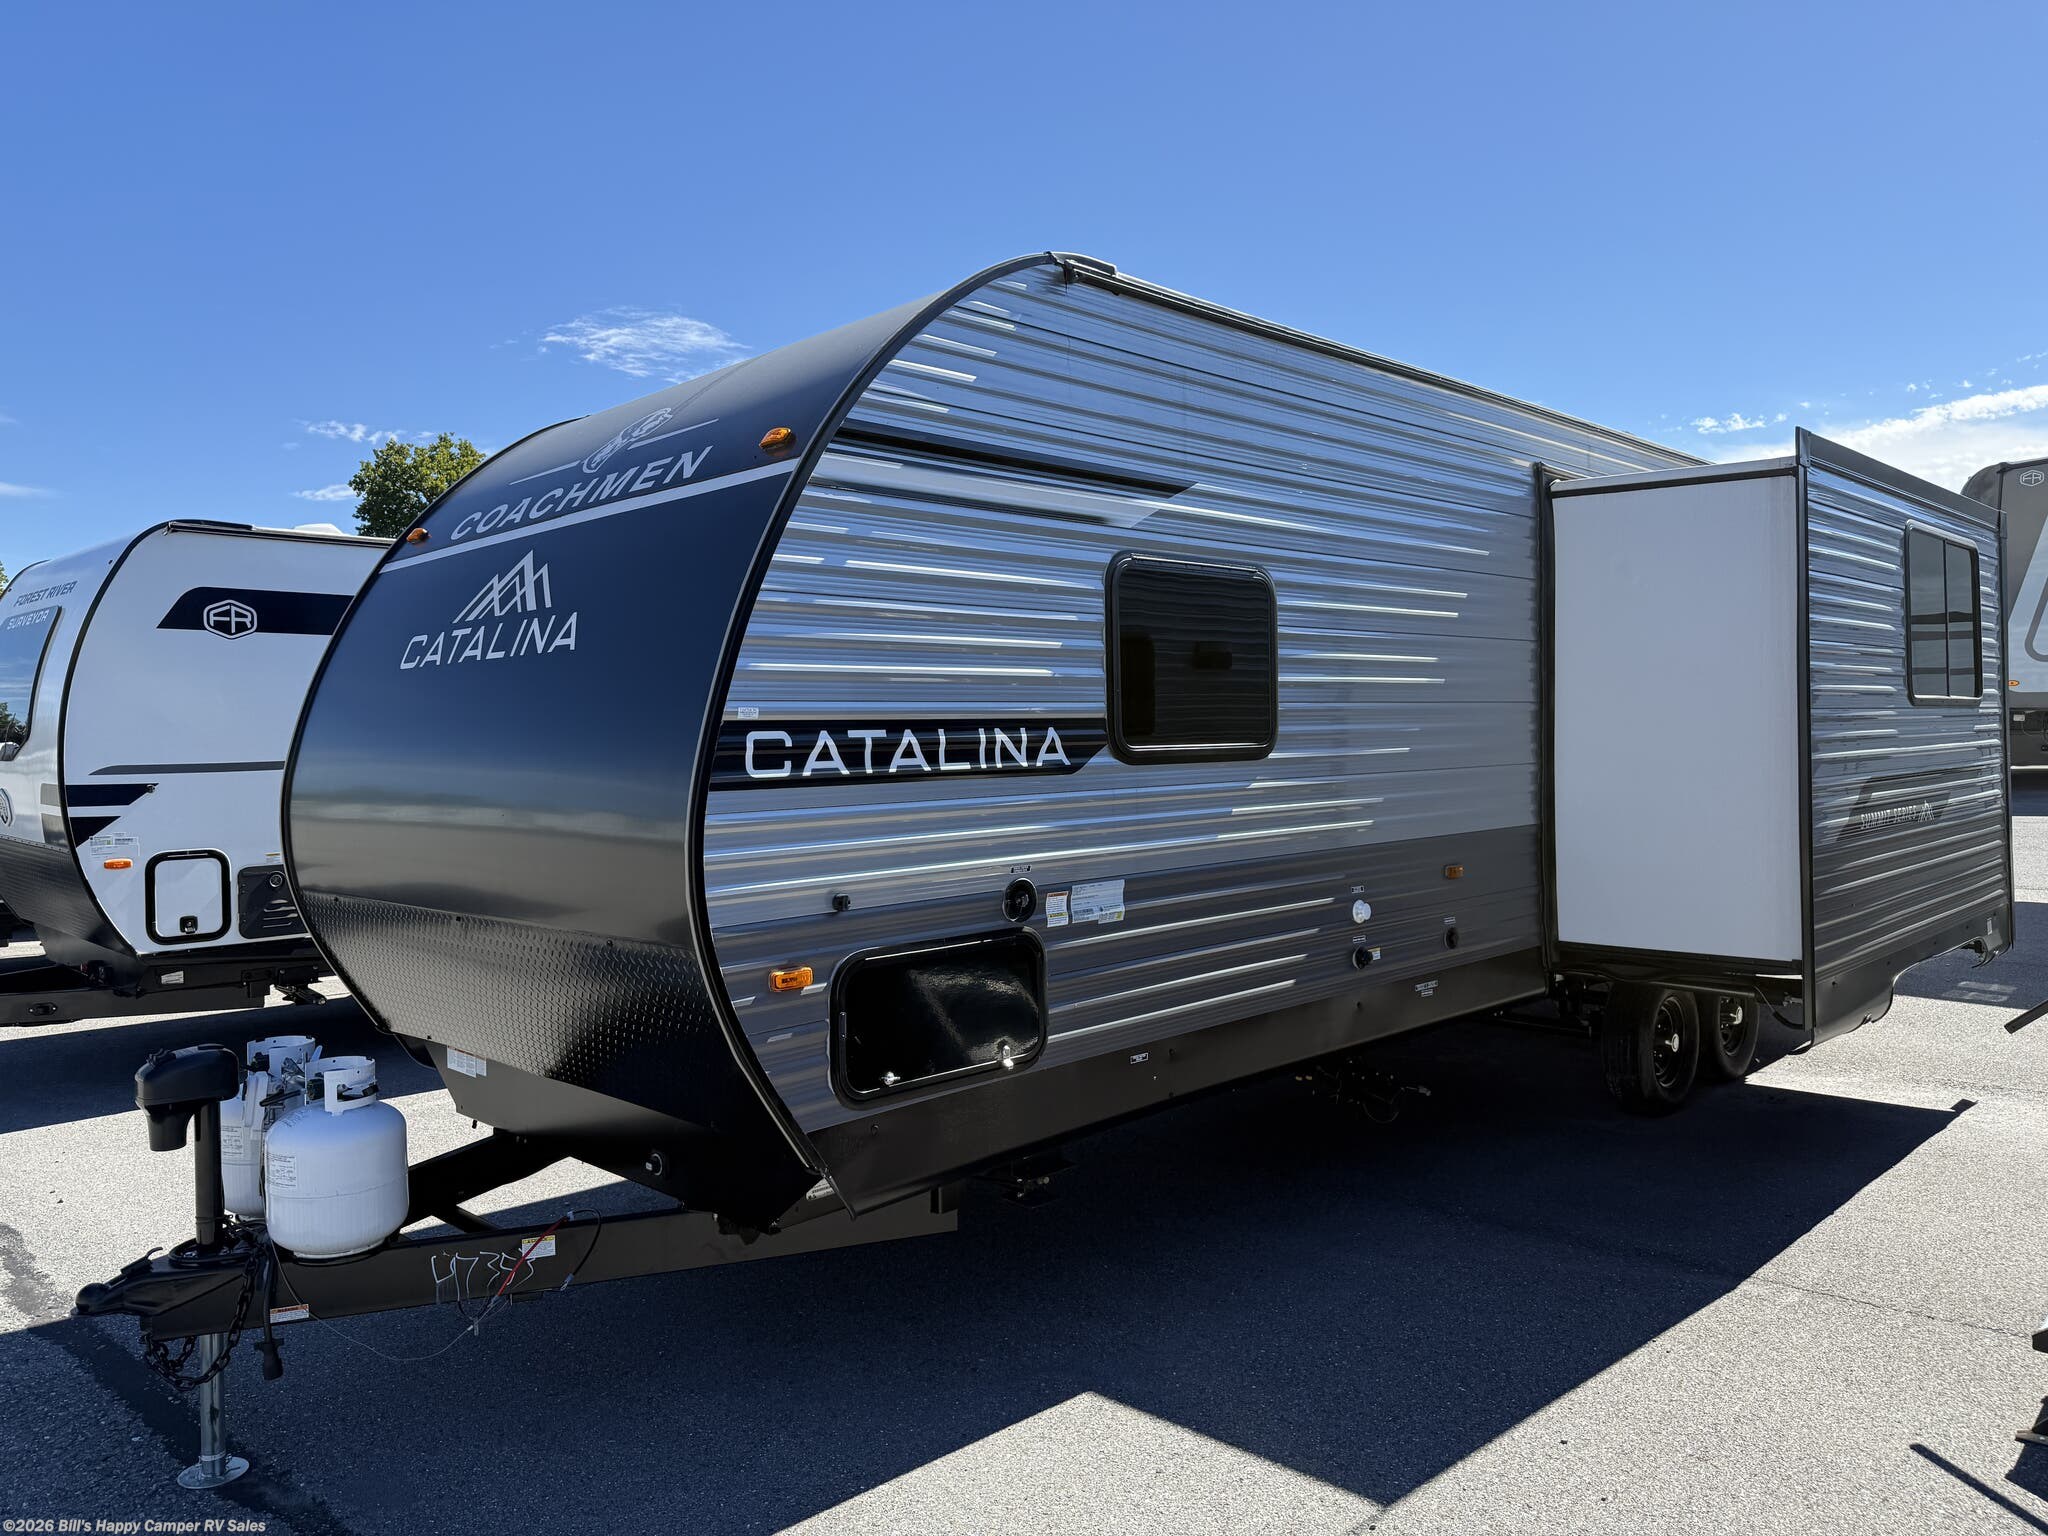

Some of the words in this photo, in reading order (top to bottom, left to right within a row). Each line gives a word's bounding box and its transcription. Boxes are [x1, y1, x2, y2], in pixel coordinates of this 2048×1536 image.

[451, 445, 713, 541] COACHMEN
[7, 609, 50, 630] SURVEYOR
[13, 588, 49, 607] FOREST
[46, 580, 78, 599] RIVER
[400, 611, 578, 670] CATALINA
[745, 726, 1071, 779] CATALINA
